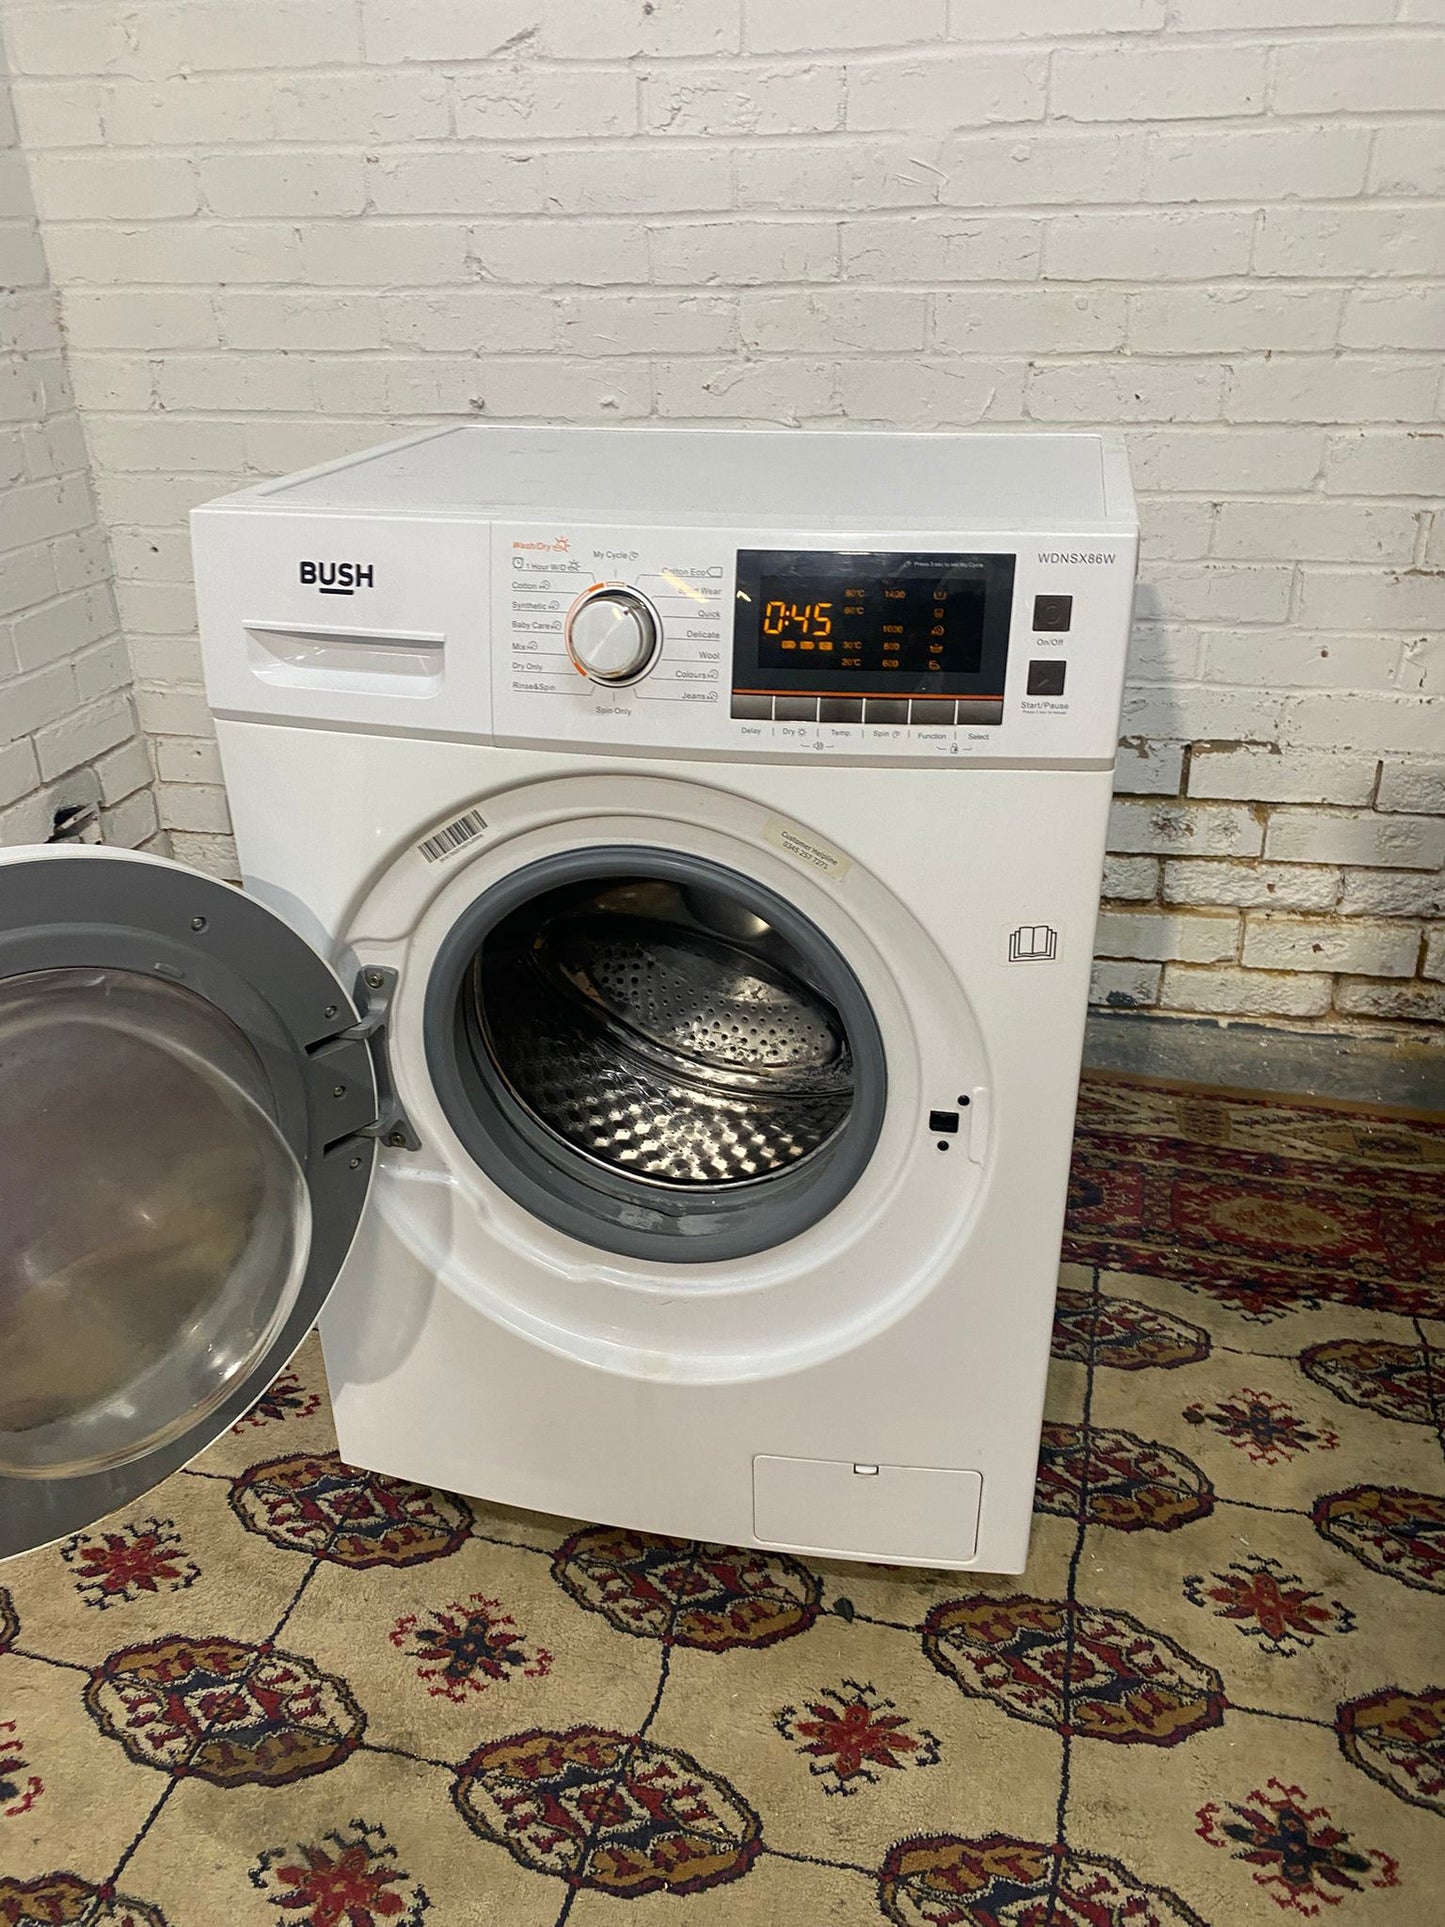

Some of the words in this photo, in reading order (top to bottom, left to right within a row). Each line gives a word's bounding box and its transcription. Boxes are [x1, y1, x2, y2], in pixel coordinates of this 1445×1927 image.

[593, 550, 604, 559] My
[606, 551, 628, 559] Cycle
[1038, 553, 1116, 564] WDNSX86W
[300, 561, 373, 588] BUSH
[690, 568, 706, 576] Eco
[512, 581, 537, 589] Cotton
[701, 587, 721, 595] Wear
[512, 601, 546, 610] Synthetic
[764, 601, 832, 636] 0:45
[512, 621, 530, 630] Baby
[686, 630, 720, 638] Delicate
[512, 642, 526, 650] Mix
[1036, 638, 1064, 647] On/Off
[699, 651, 720, 659] Wool
[512, 662, 525, 670] Dry
[526, 662, 542, 671] Only
[675, 670, 706, 678] Colours
[512, 681, 556, 691] Rinse&Spin
[682, 692, 705, 700] Jeans
[1021, 701, 1070, 710] Start/Pause
[596, 706, 613, 715] Spin
[614, 707, 632, 716] Only
[741, 727, 762, 735] Delay
[782, 727, 795, 736] Dry
[873, 730, 889, 738] Spin
[918, 732, 947, 740] Function
[781, 831, 812, 851] Customer
[782, 841, 800, 854] 0345
[799, 850, 813, 861] 257
